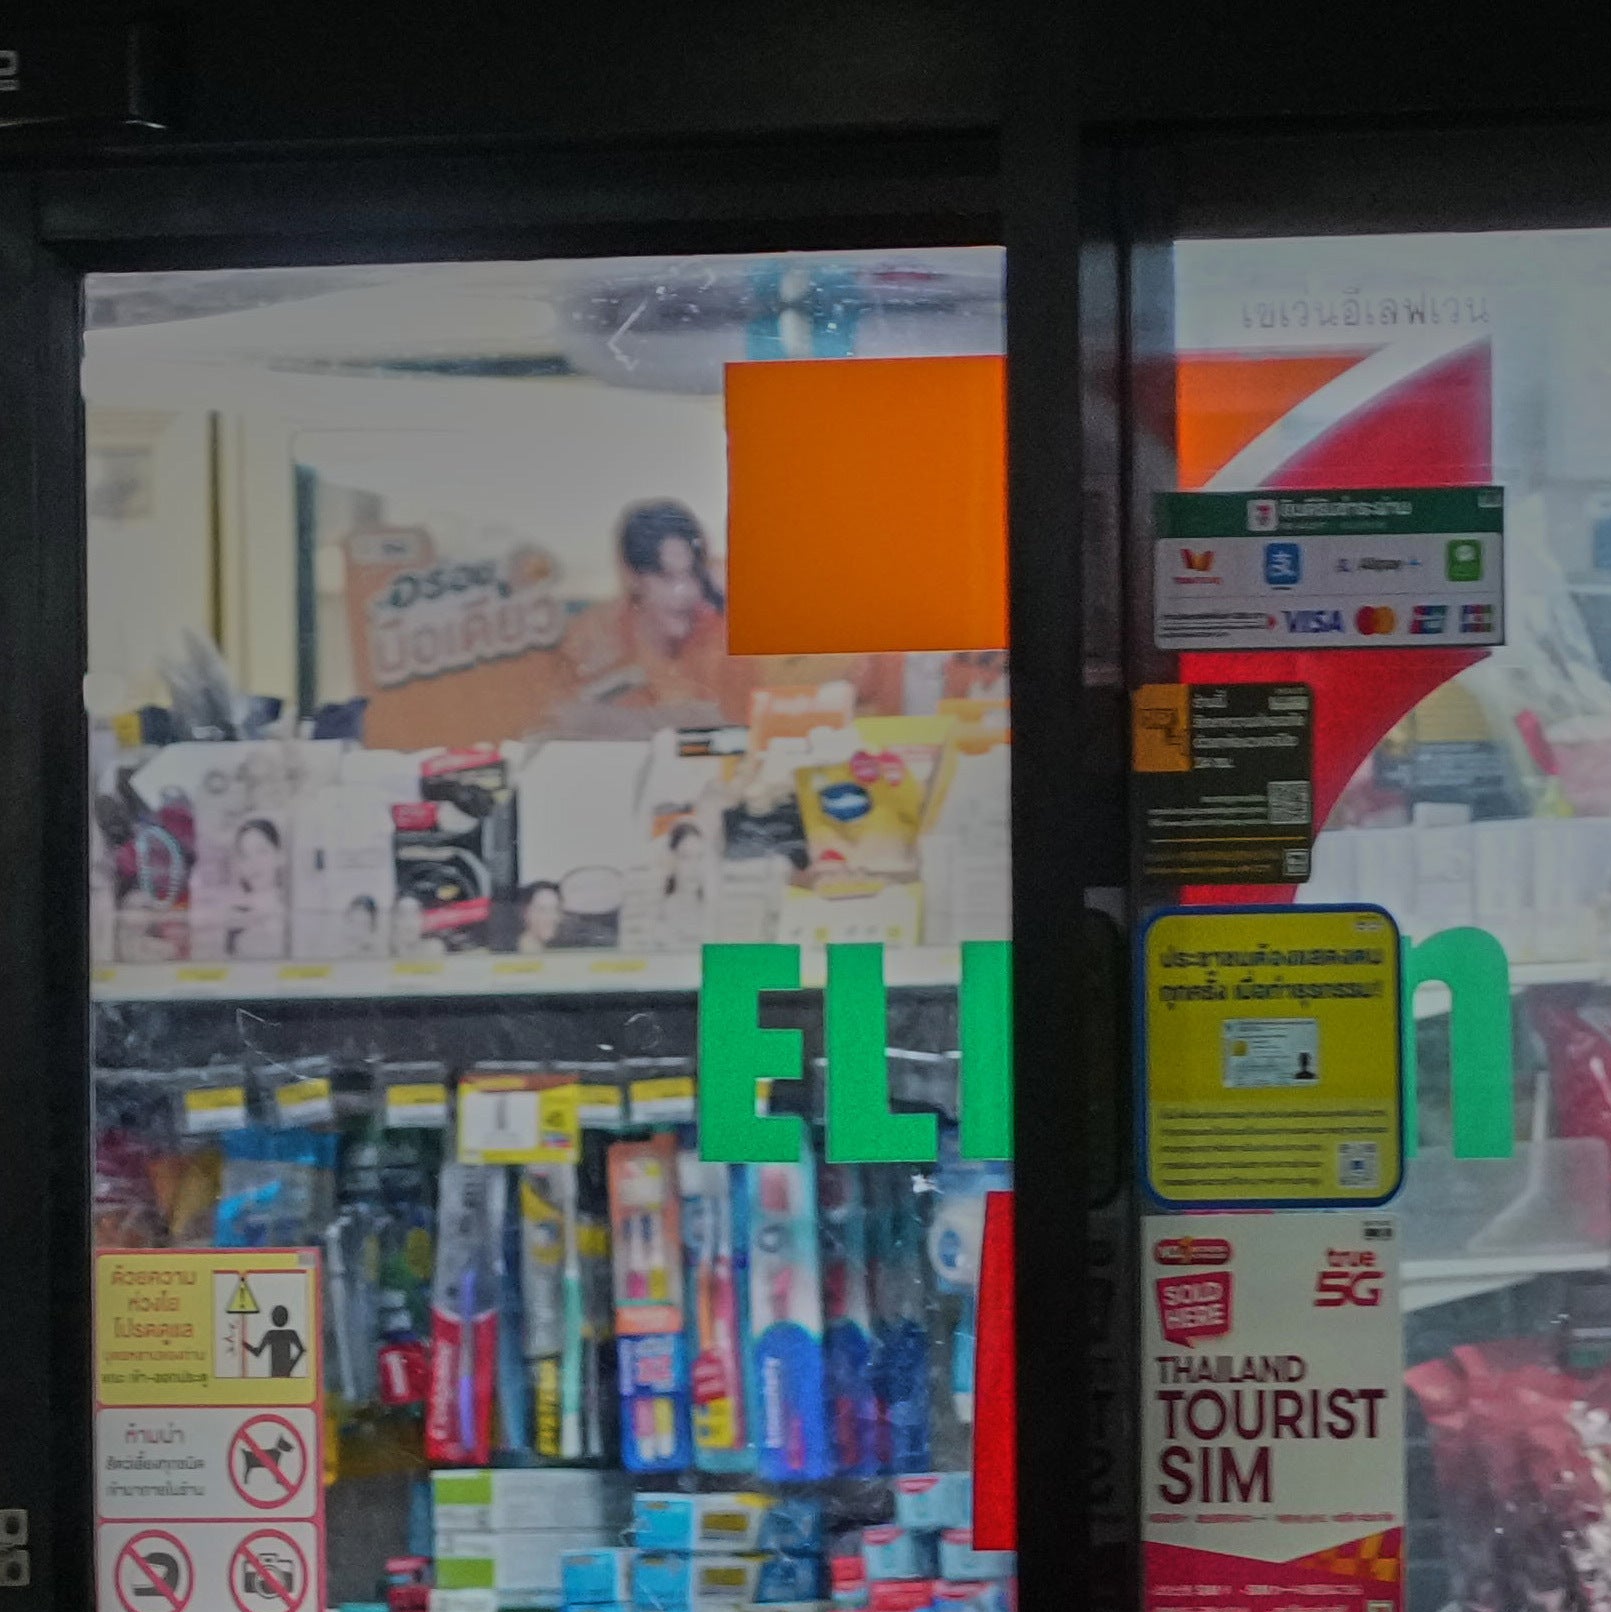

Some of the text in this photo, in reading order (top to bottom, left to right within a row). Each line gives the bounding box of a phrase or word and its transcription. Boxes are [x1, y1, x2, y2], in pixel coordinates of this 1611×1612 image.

[1281, 609, 1345, 634] VISA
[1326, 1248, 1377, 1268] true
[1161, 1281, 1225, 1306] SOLD
[1313, 1271, 1386, 1308] 5G
[1165, 1302, 1227, 1329] HERE
[1155, 1355, 1309, 1384] THAILAND
[1156, 1387, 1388, 1441] TOURIST
[1158, 1446, 1273, 1504] SIM
